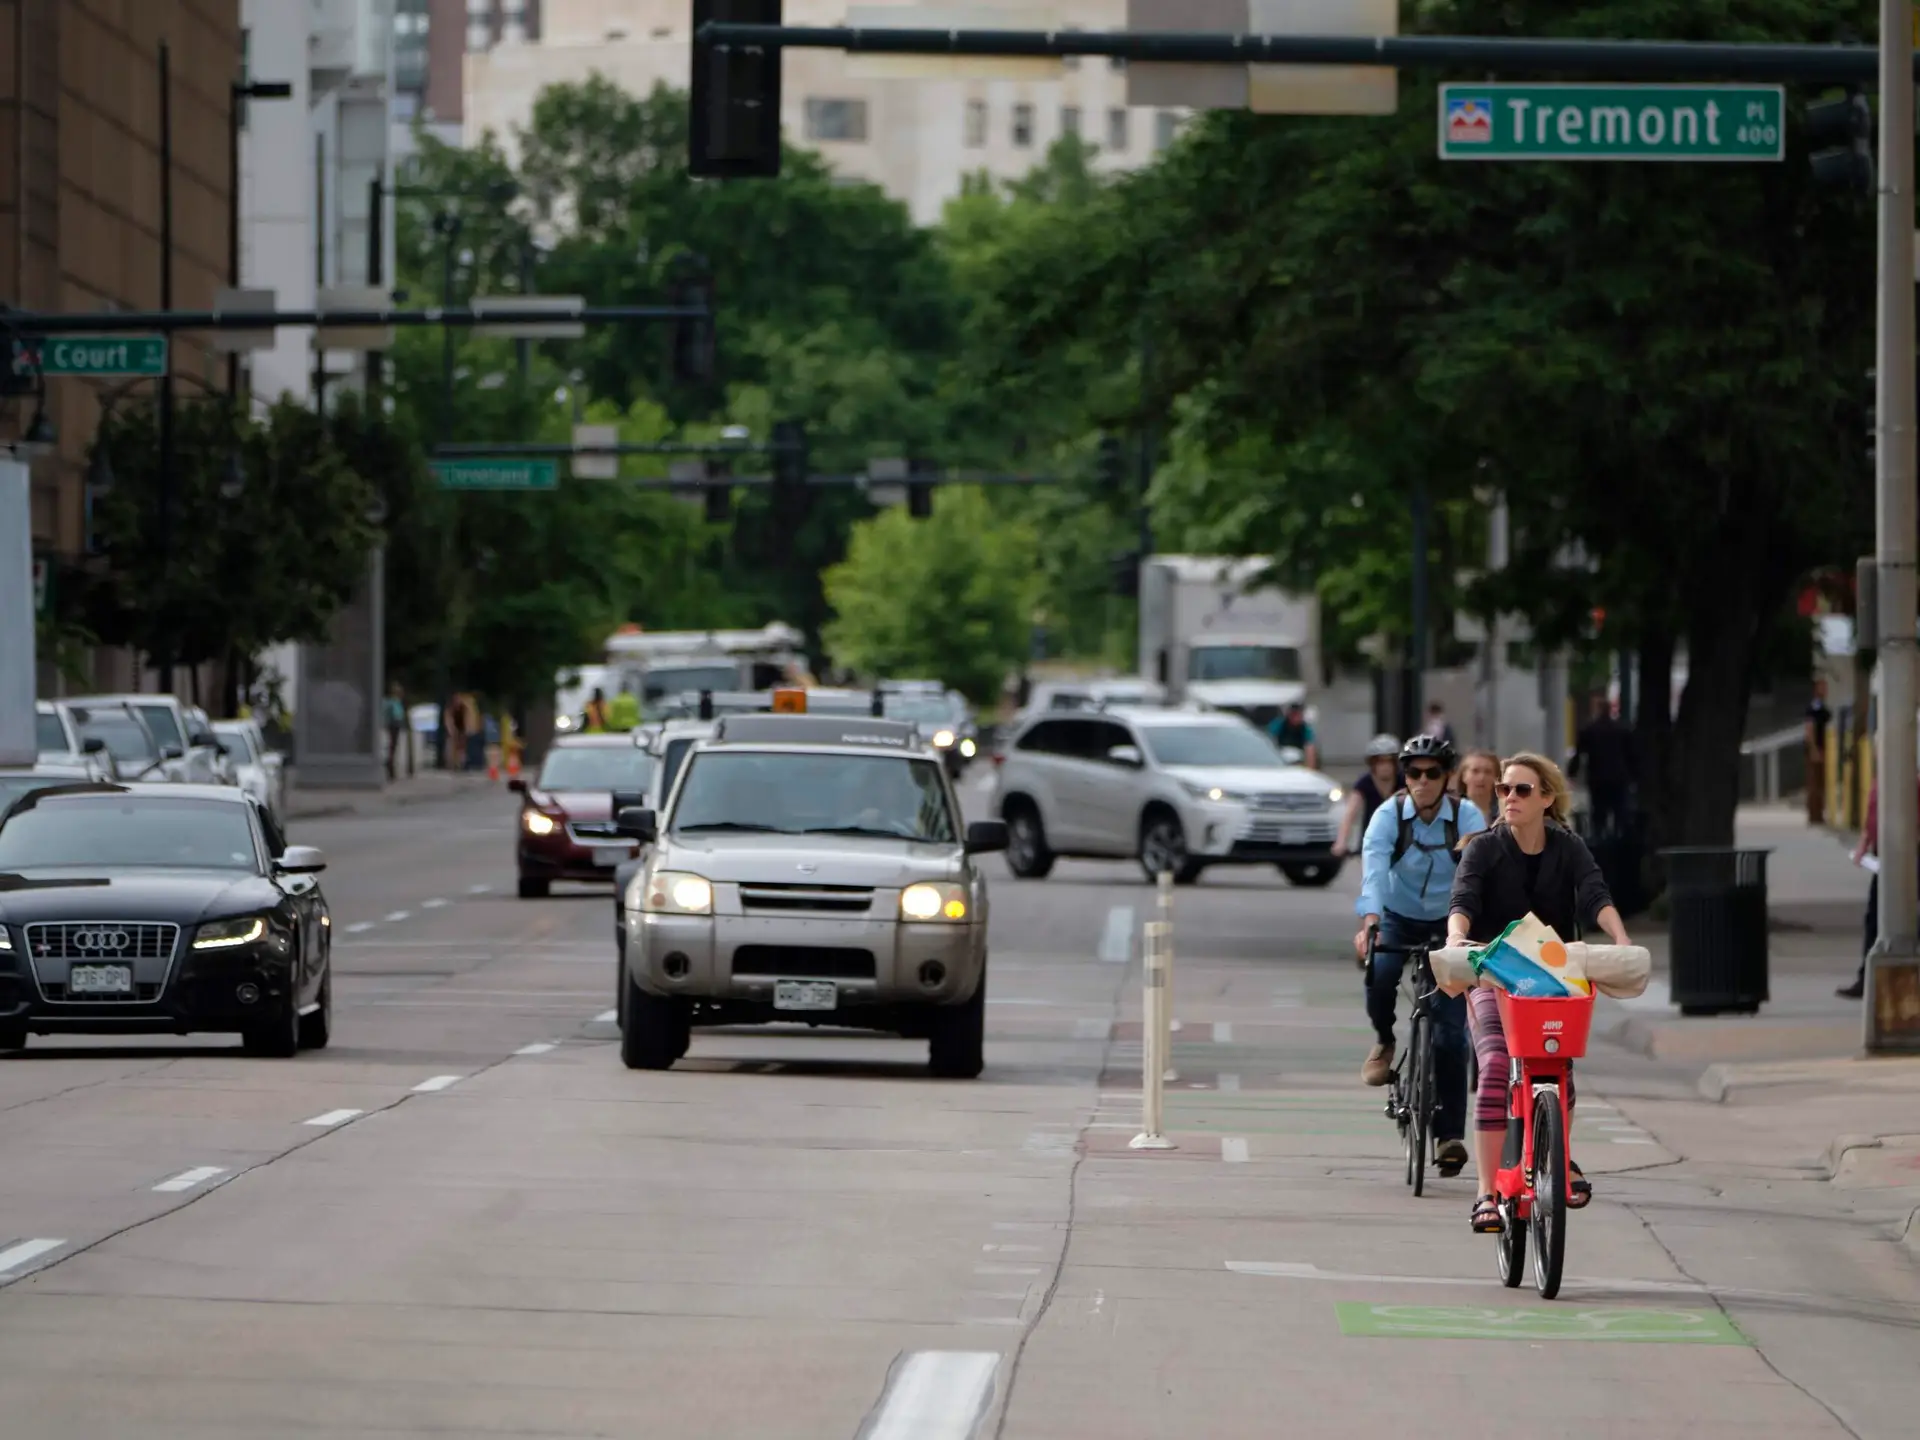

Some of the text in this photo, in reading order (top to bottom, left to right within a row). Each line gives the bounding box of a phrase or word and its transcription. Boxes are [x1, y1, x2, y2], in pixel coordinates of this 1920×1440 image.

[1507, 98, 1722, 146] Tremont
[1746, 101, 1766, 122] Pl
[1736, 124, 1777, 146] 400
[54, 343, 128, 369] Court
[1541, 1019, 1564, 1030] JUMP
